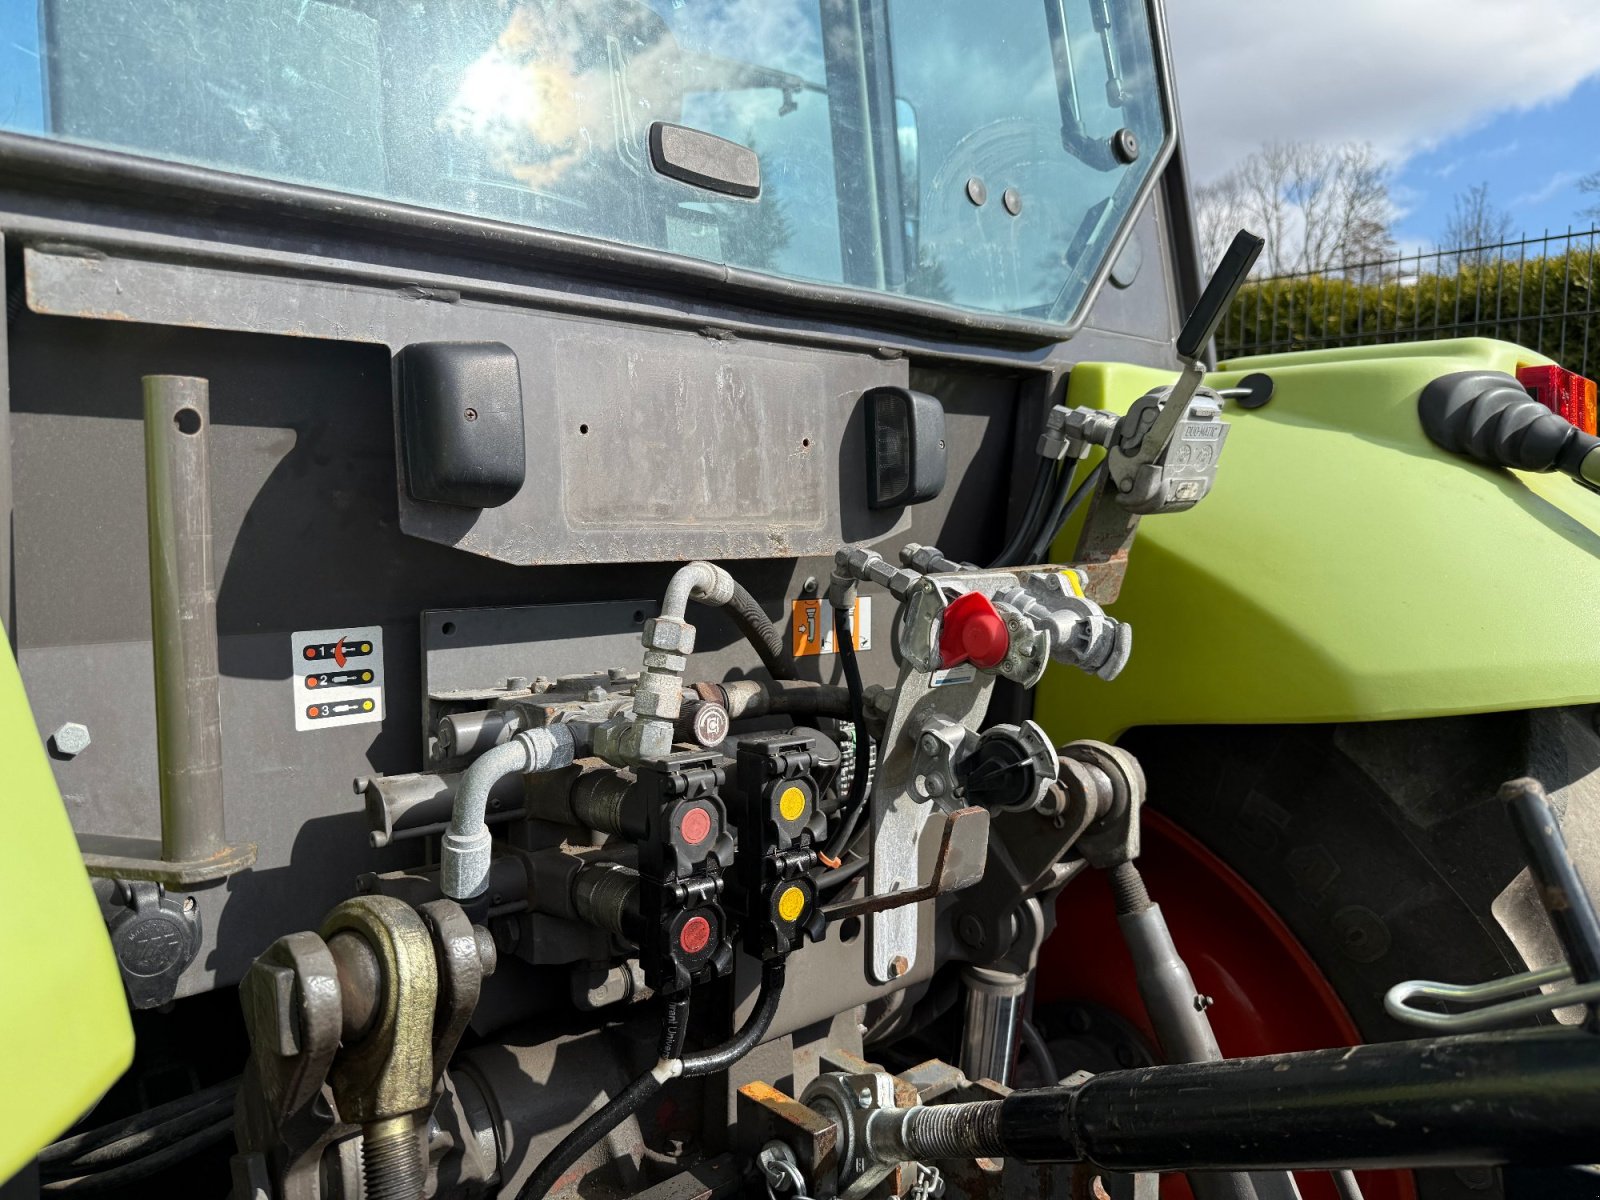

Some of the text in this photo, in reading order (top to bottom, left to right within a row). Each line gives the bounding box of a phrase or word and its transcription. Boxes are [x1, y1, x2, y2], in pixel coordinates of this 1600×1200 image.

[319, 646, 325, 656] 1
[320, 675, 328, 686] 2
[321, 705, 329, 716] 3
